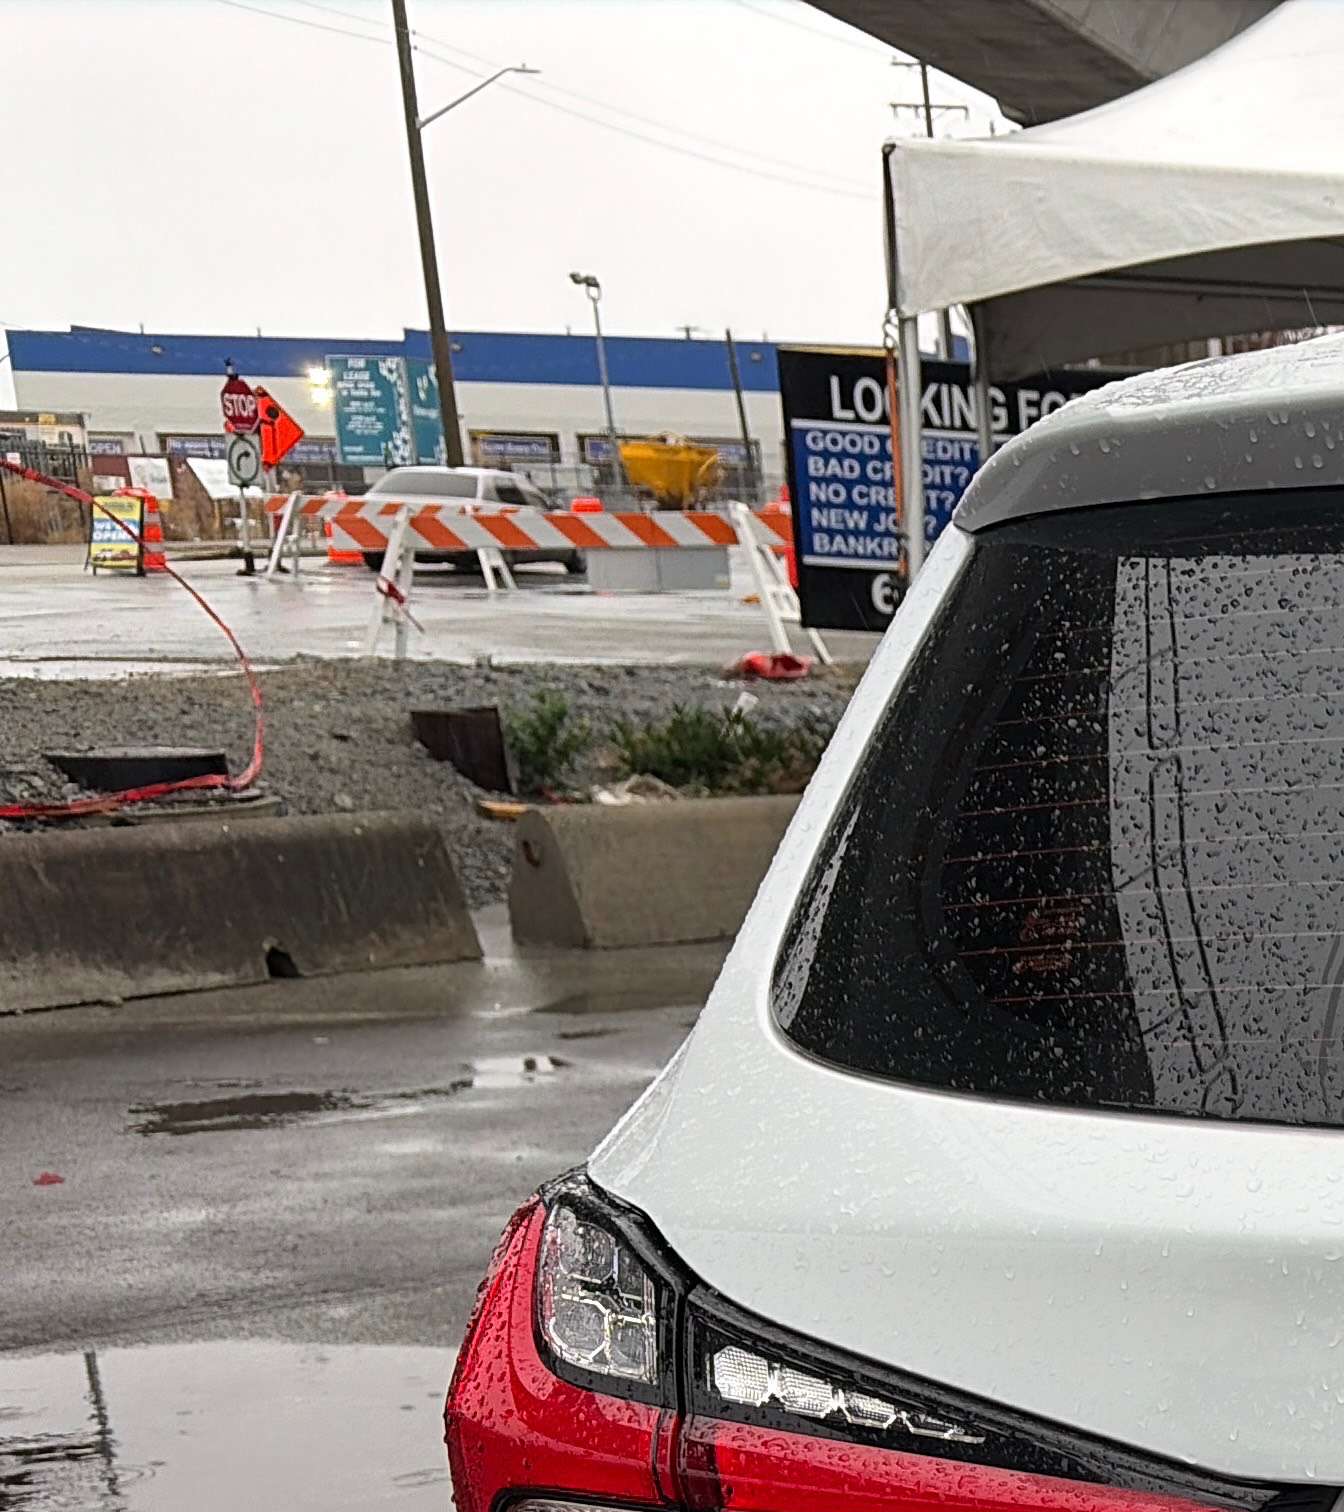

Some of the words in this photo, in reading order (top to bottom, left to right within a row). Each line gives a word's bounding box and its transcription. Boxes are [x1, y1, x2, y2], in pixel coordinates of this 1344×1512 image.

[223, 393, 256, 418] STOP
[830, 375, 1008, 430] LOKING
[1018, 388, 1081, 430] FO
[805, 430, 881, 455] GOOD
[807, 456, 861, 480] BAD
[809, 481, 847, 504] NO
[810, 507, 868, 530] NEW
[873, 511, 937, 535] JO?
